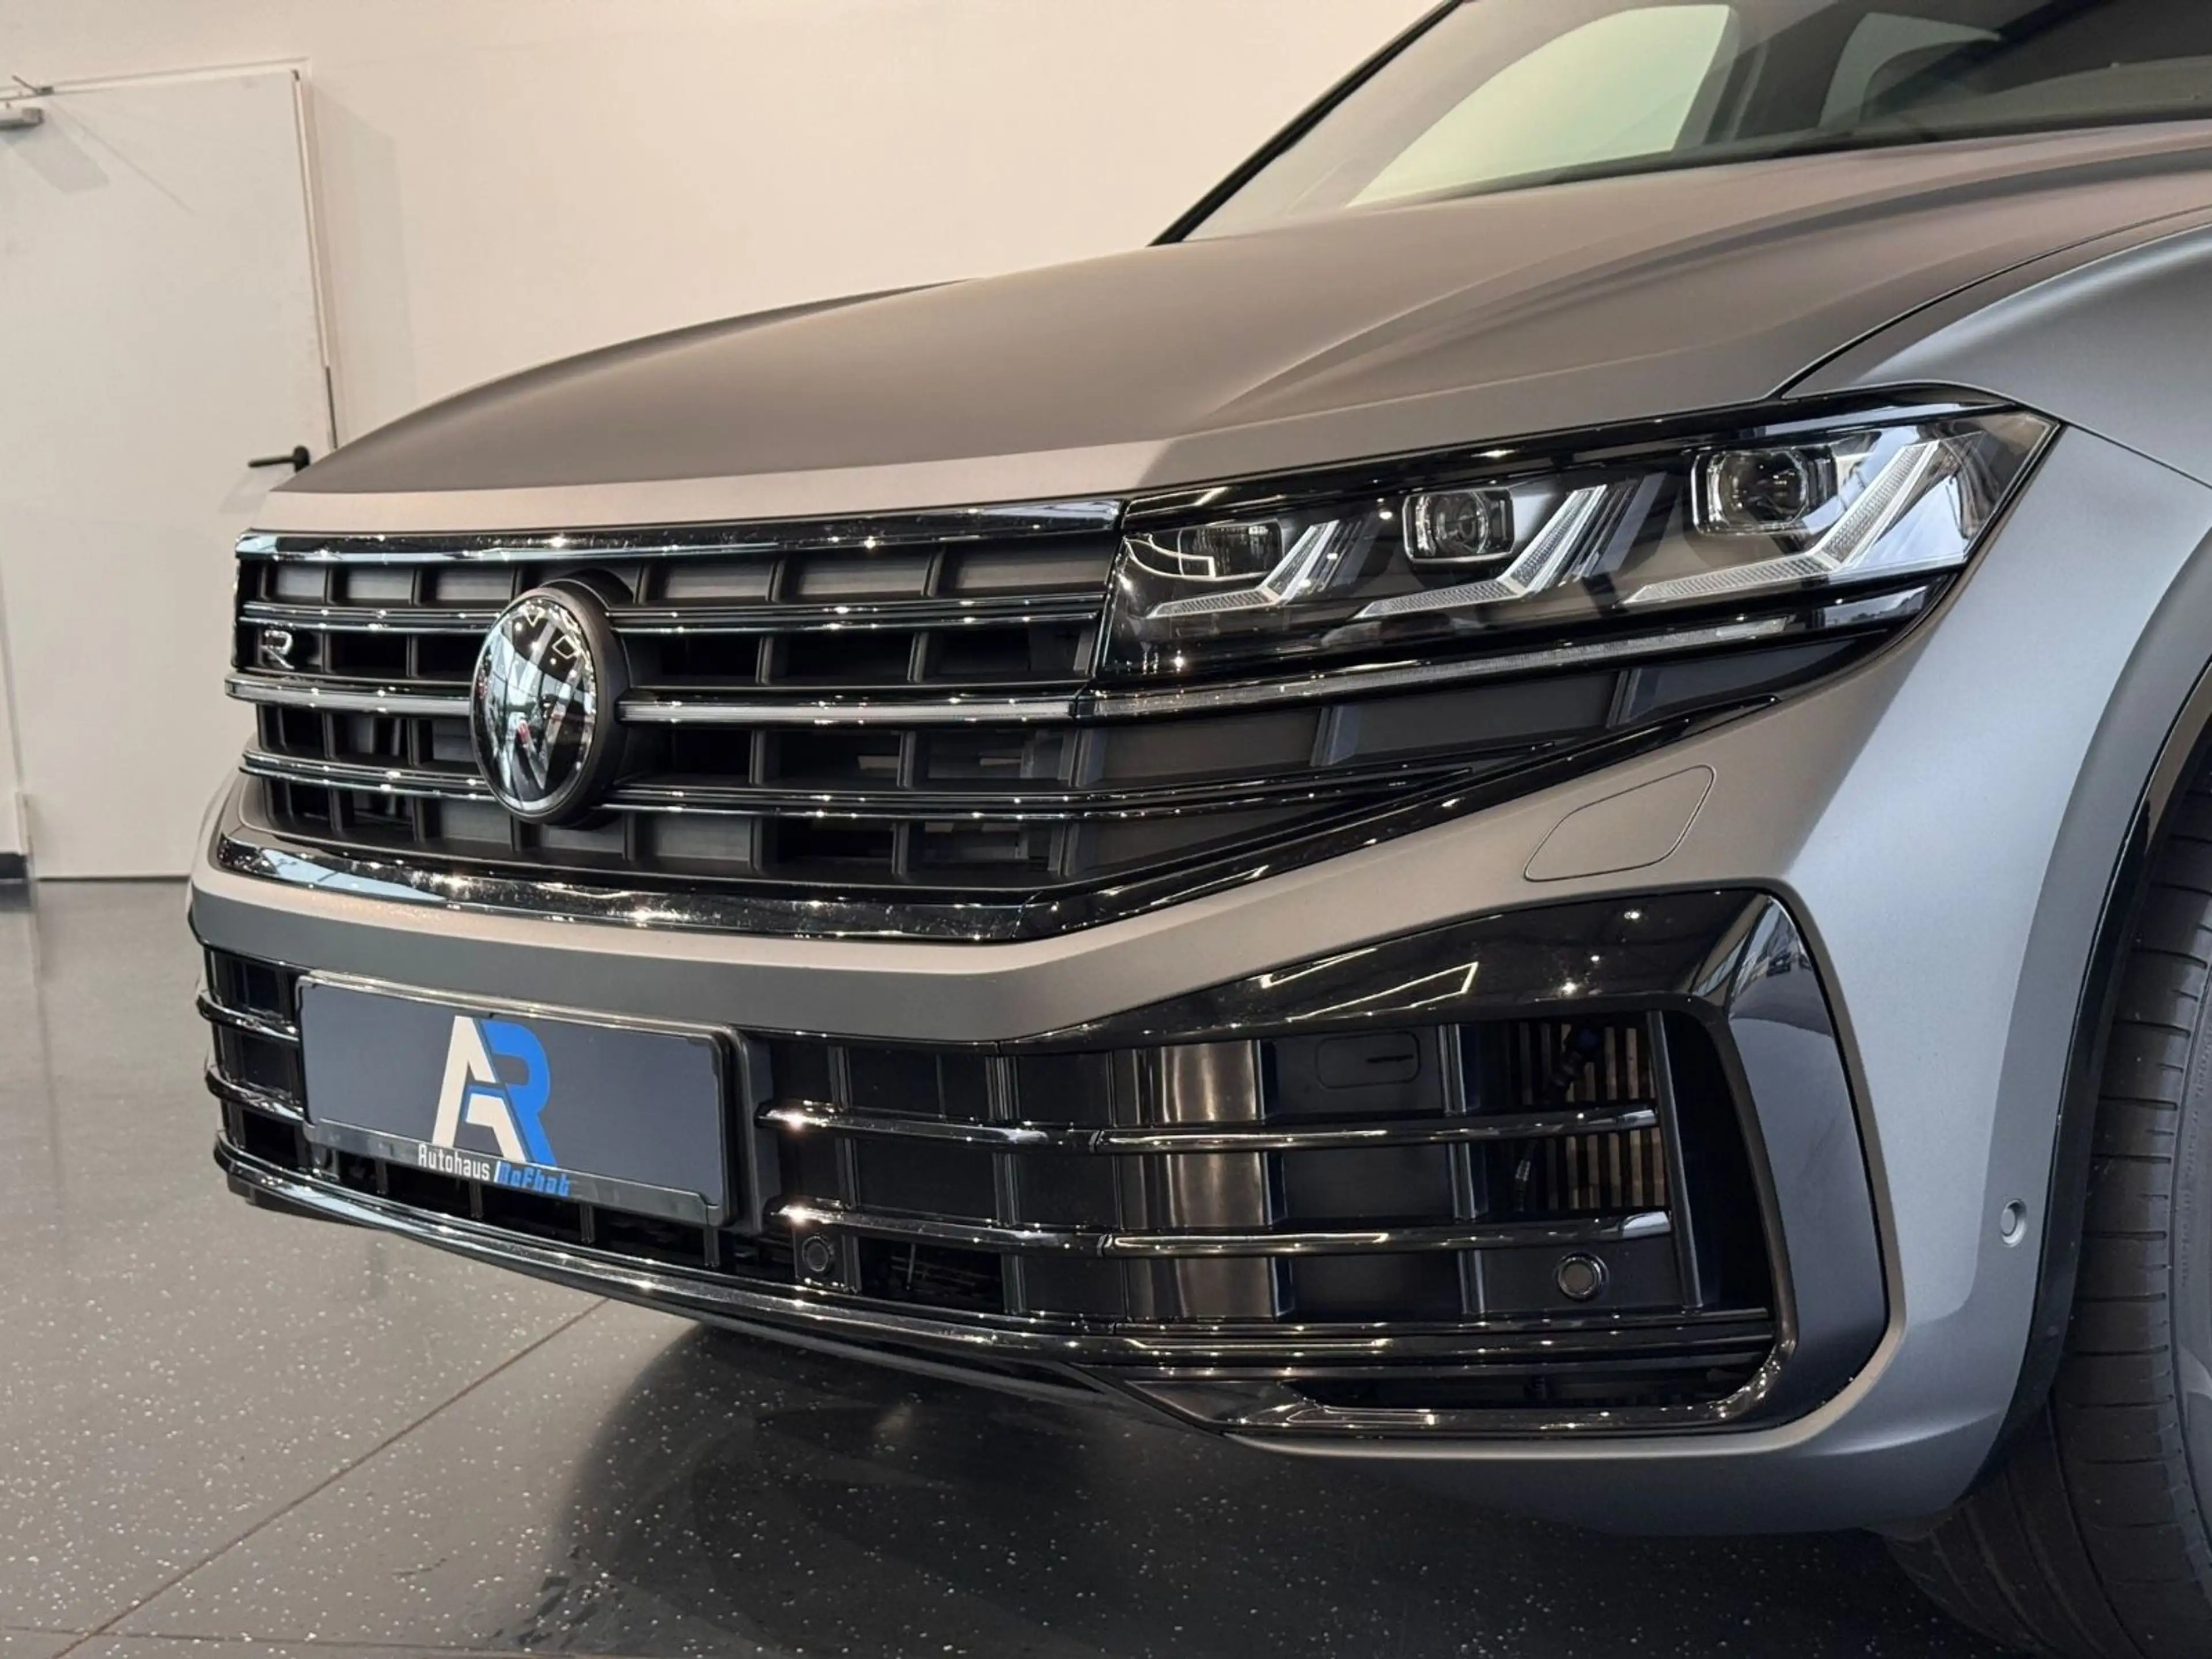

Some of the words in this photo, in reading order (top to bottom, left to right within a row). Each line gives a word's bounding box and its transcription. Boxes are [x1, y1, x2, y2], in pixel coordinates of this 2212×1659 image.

[260, 630, 295, 670] R
[432, 1016, 557, 1165] AR
[418, 1142, 490, 1181] Autohaus
